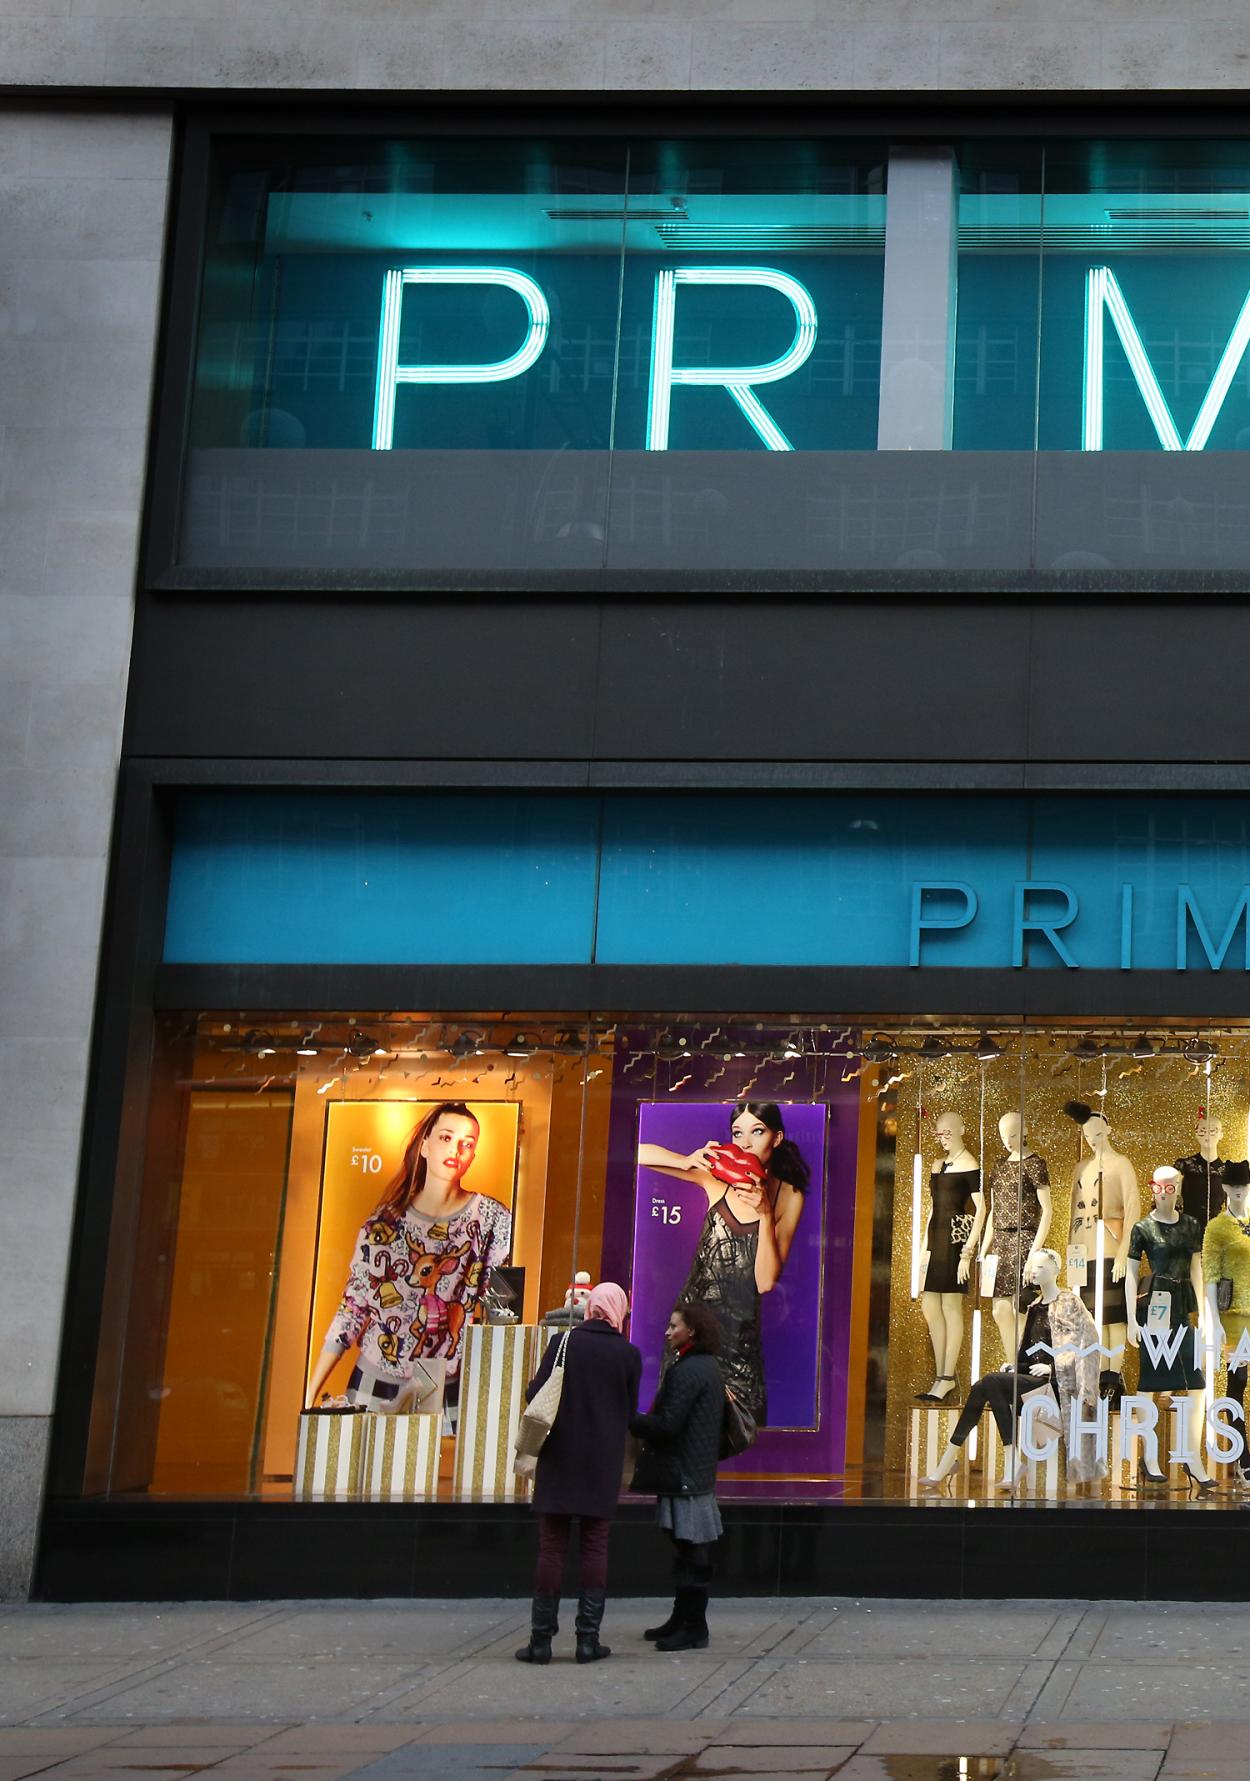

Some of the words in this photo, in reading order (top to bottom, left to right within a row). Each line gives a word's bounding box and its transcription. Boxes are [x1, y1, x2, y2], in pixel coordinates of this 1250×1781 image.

[351, 1154, 382, 1174] £10
[651, 1206, 681, 1224] £15
[1068, 1258, 1085, 1268] £14
[1151, 1305, 1168, 1320] £7
